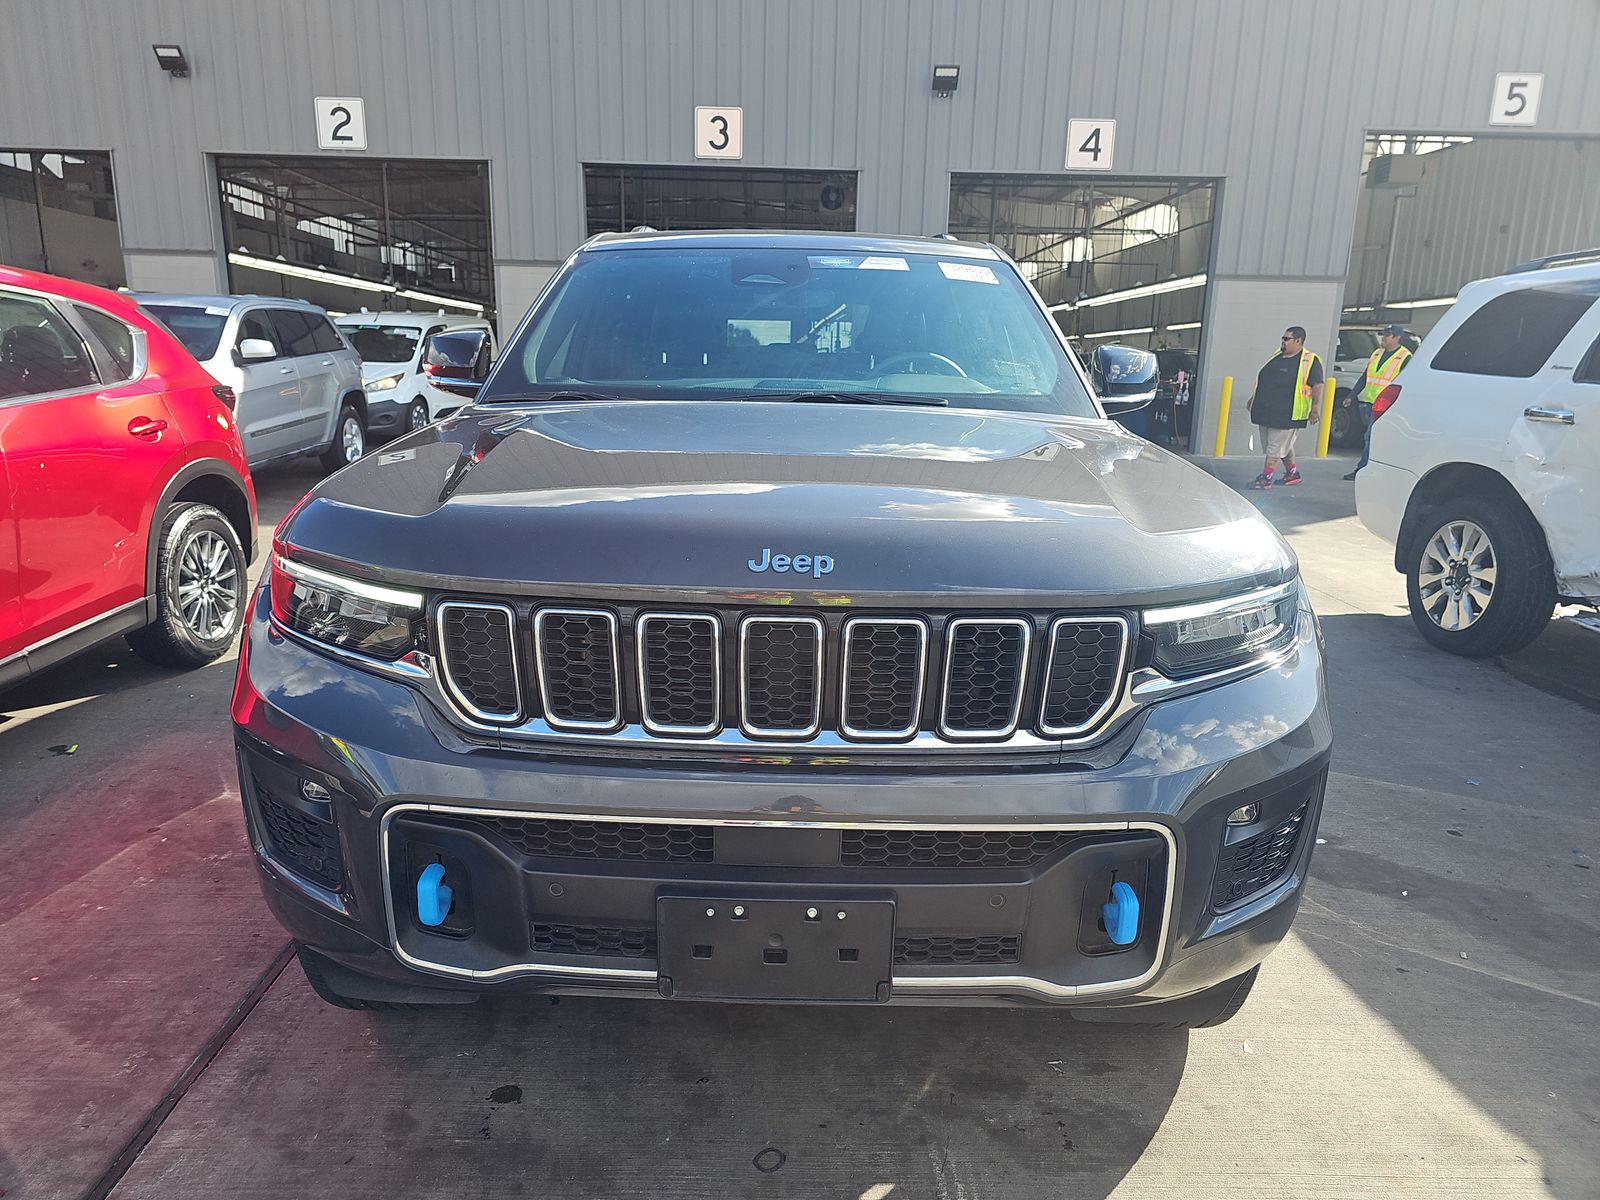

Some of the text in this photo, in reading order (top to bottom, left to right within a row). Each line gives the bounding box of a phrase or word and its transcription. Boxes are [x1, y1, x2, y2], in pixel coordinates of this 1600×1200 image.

[1504, 82, 1528, 117] 5
[330, 106, 353, 141] 2
[708, 115, 729, 151] 3
[1078, 127, 1102, 162] 4
[747, 547, 835, 579] Jeep
